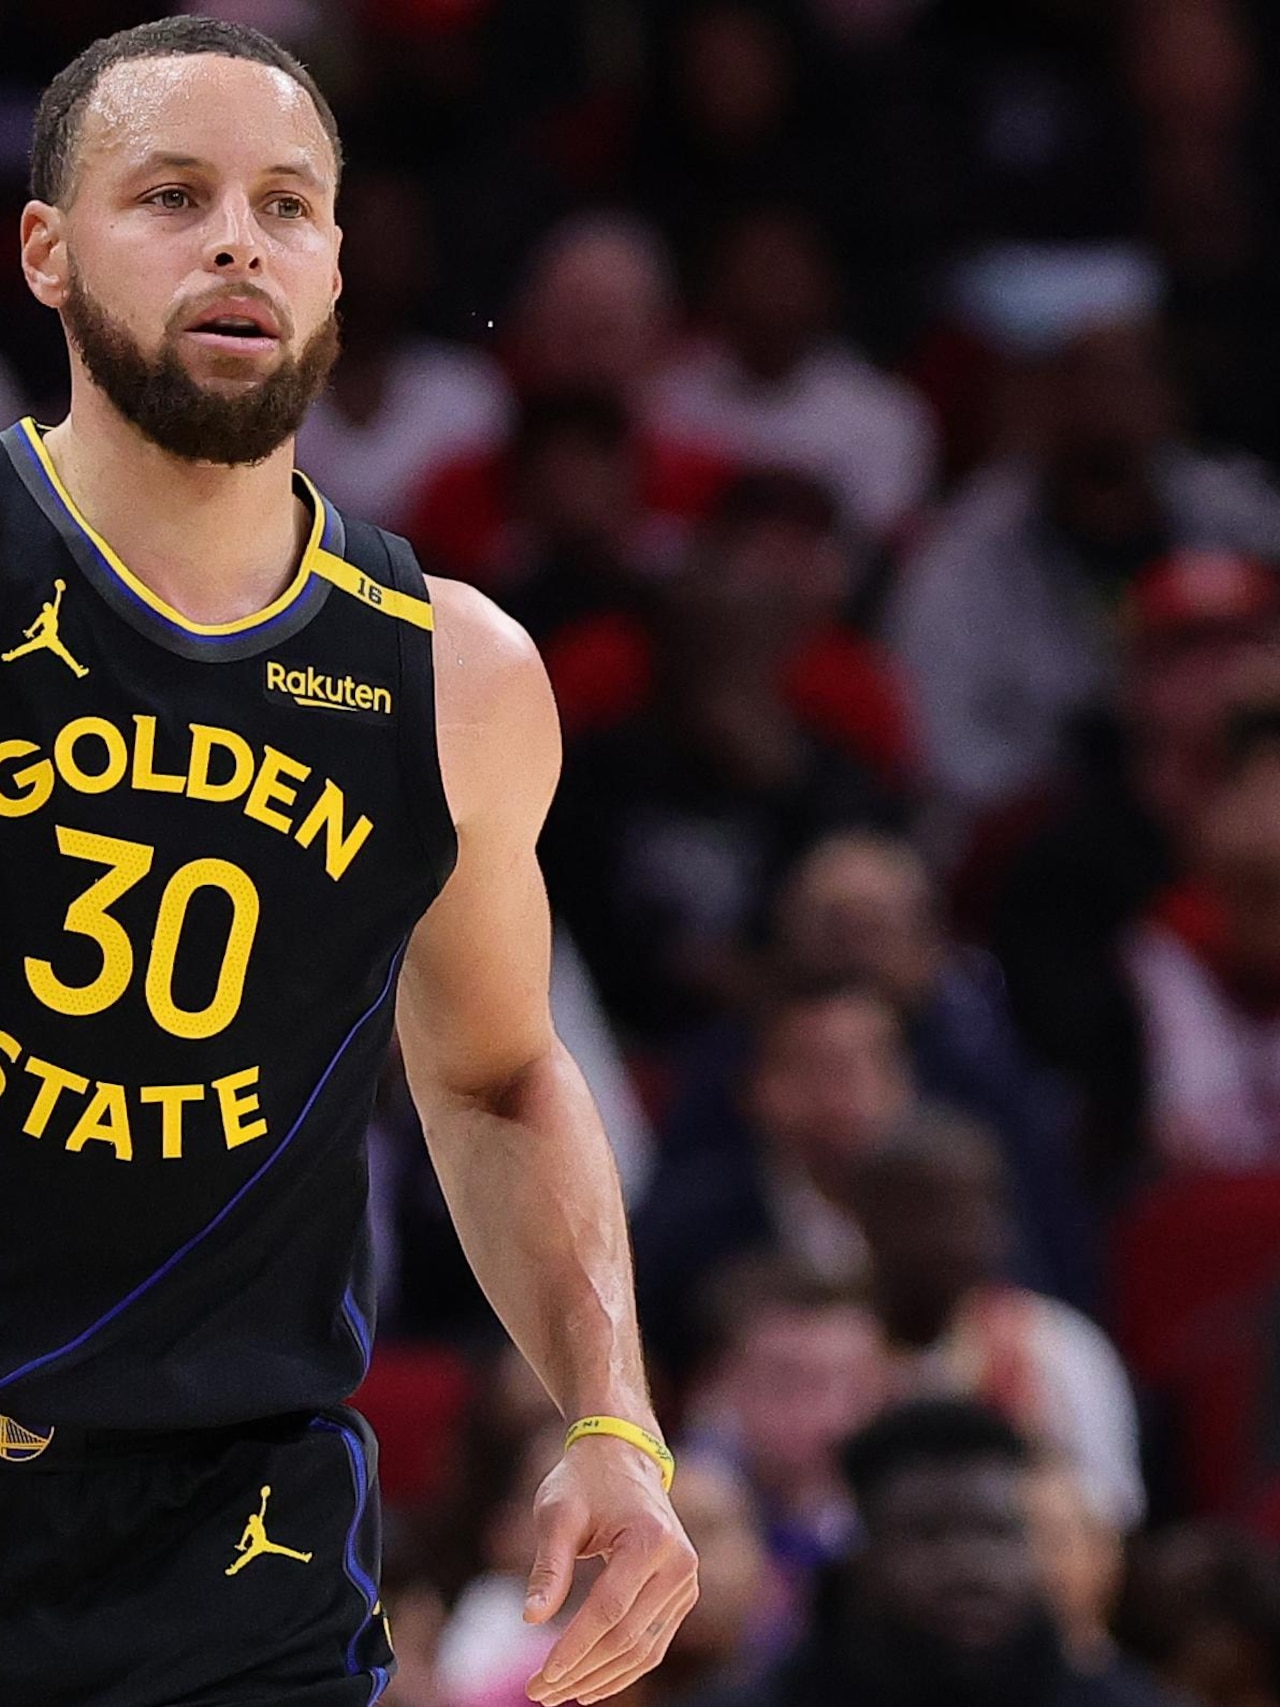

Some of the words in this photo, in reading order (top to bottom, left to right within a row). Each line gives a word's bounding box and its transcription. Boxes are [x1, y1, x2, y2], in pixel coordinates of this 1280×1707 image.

[357, 577, 382, 605] 16
[267, 661, 391, 714] Rakuten
[24, 825, 260, 1039] 30
